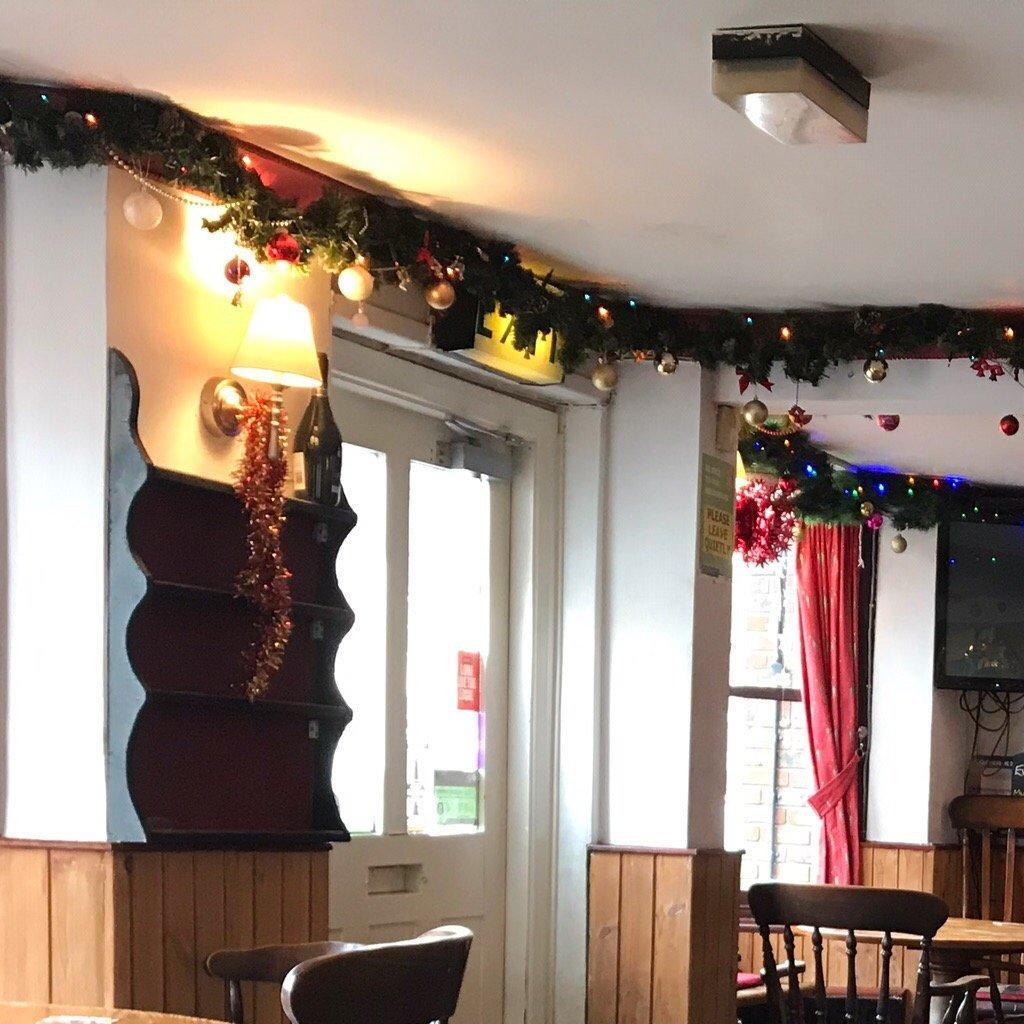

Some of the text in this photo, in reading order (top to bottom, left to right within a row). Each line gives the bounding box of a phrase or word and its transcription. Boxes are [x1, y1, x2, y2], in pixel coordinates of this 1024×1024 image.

[706, 508, 730, 526] PLEASE
[708, 525, 728, 541] LEAVE
[704, 538, 731, 555] QUIETLY
